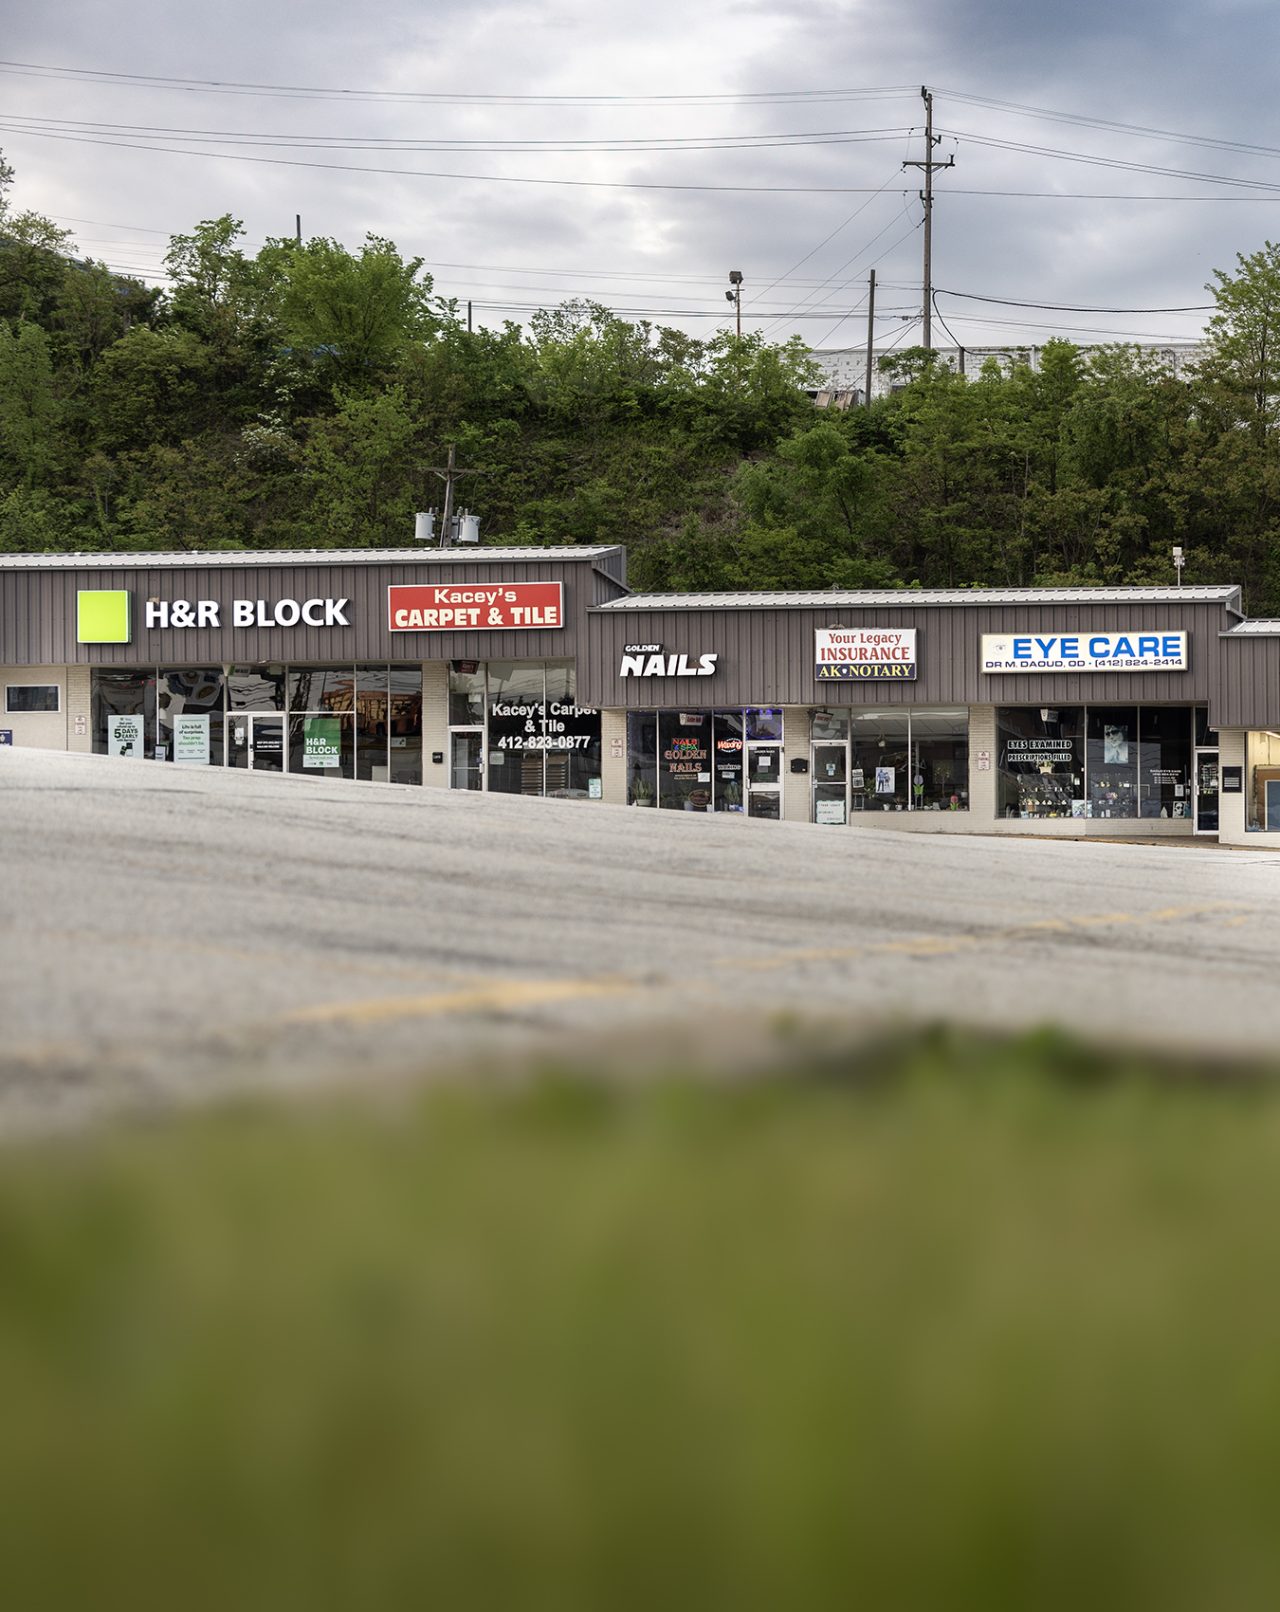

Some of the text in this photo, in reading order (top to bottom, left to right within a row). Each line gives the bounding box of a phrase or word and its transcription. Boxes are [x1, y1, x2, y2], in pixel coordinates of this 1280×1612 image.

[434, 588, 517, 605] Kacey's
[145, 598, 350, 628] H&R BLOCK
[395, 606, 557, 627] CARPET & TILE
[829, 633, 902, 646] Your Legacy
[625, 644, 660, 652] GOLDEN
[820, 647, 910, 660] INSURANCE
[1013, 636, 1181, 659] EYE CARE
[620, 653, 718, 677] NAILS
[986, 660, 1002, 668] DR
[1005, 660, 1018, 668] M.
[1020, 660, 1066, 669] DAOUD,
[1125, 658, 1182, 667] 824-2414
[819, 664, 912, 677] AK NOTARY
[492, 702, 545, 718] Kacey's
[524, 719, 566, 732] & Tile
[114, 728, 122, 739] 5
[306, 737, 327, 746] H&R
[497, 736, 591, 749] 412-823-0877
[1008, 740, 1073, 749] EYES EXAMINED
[305, 746, 338, 754] BLOCK
[664, 750, 707, 760] GOLDEN
[1008, 753, 1073, 762] PRESCRIPTIONS FILLED
[669, 762, 703, 773] NAILS
